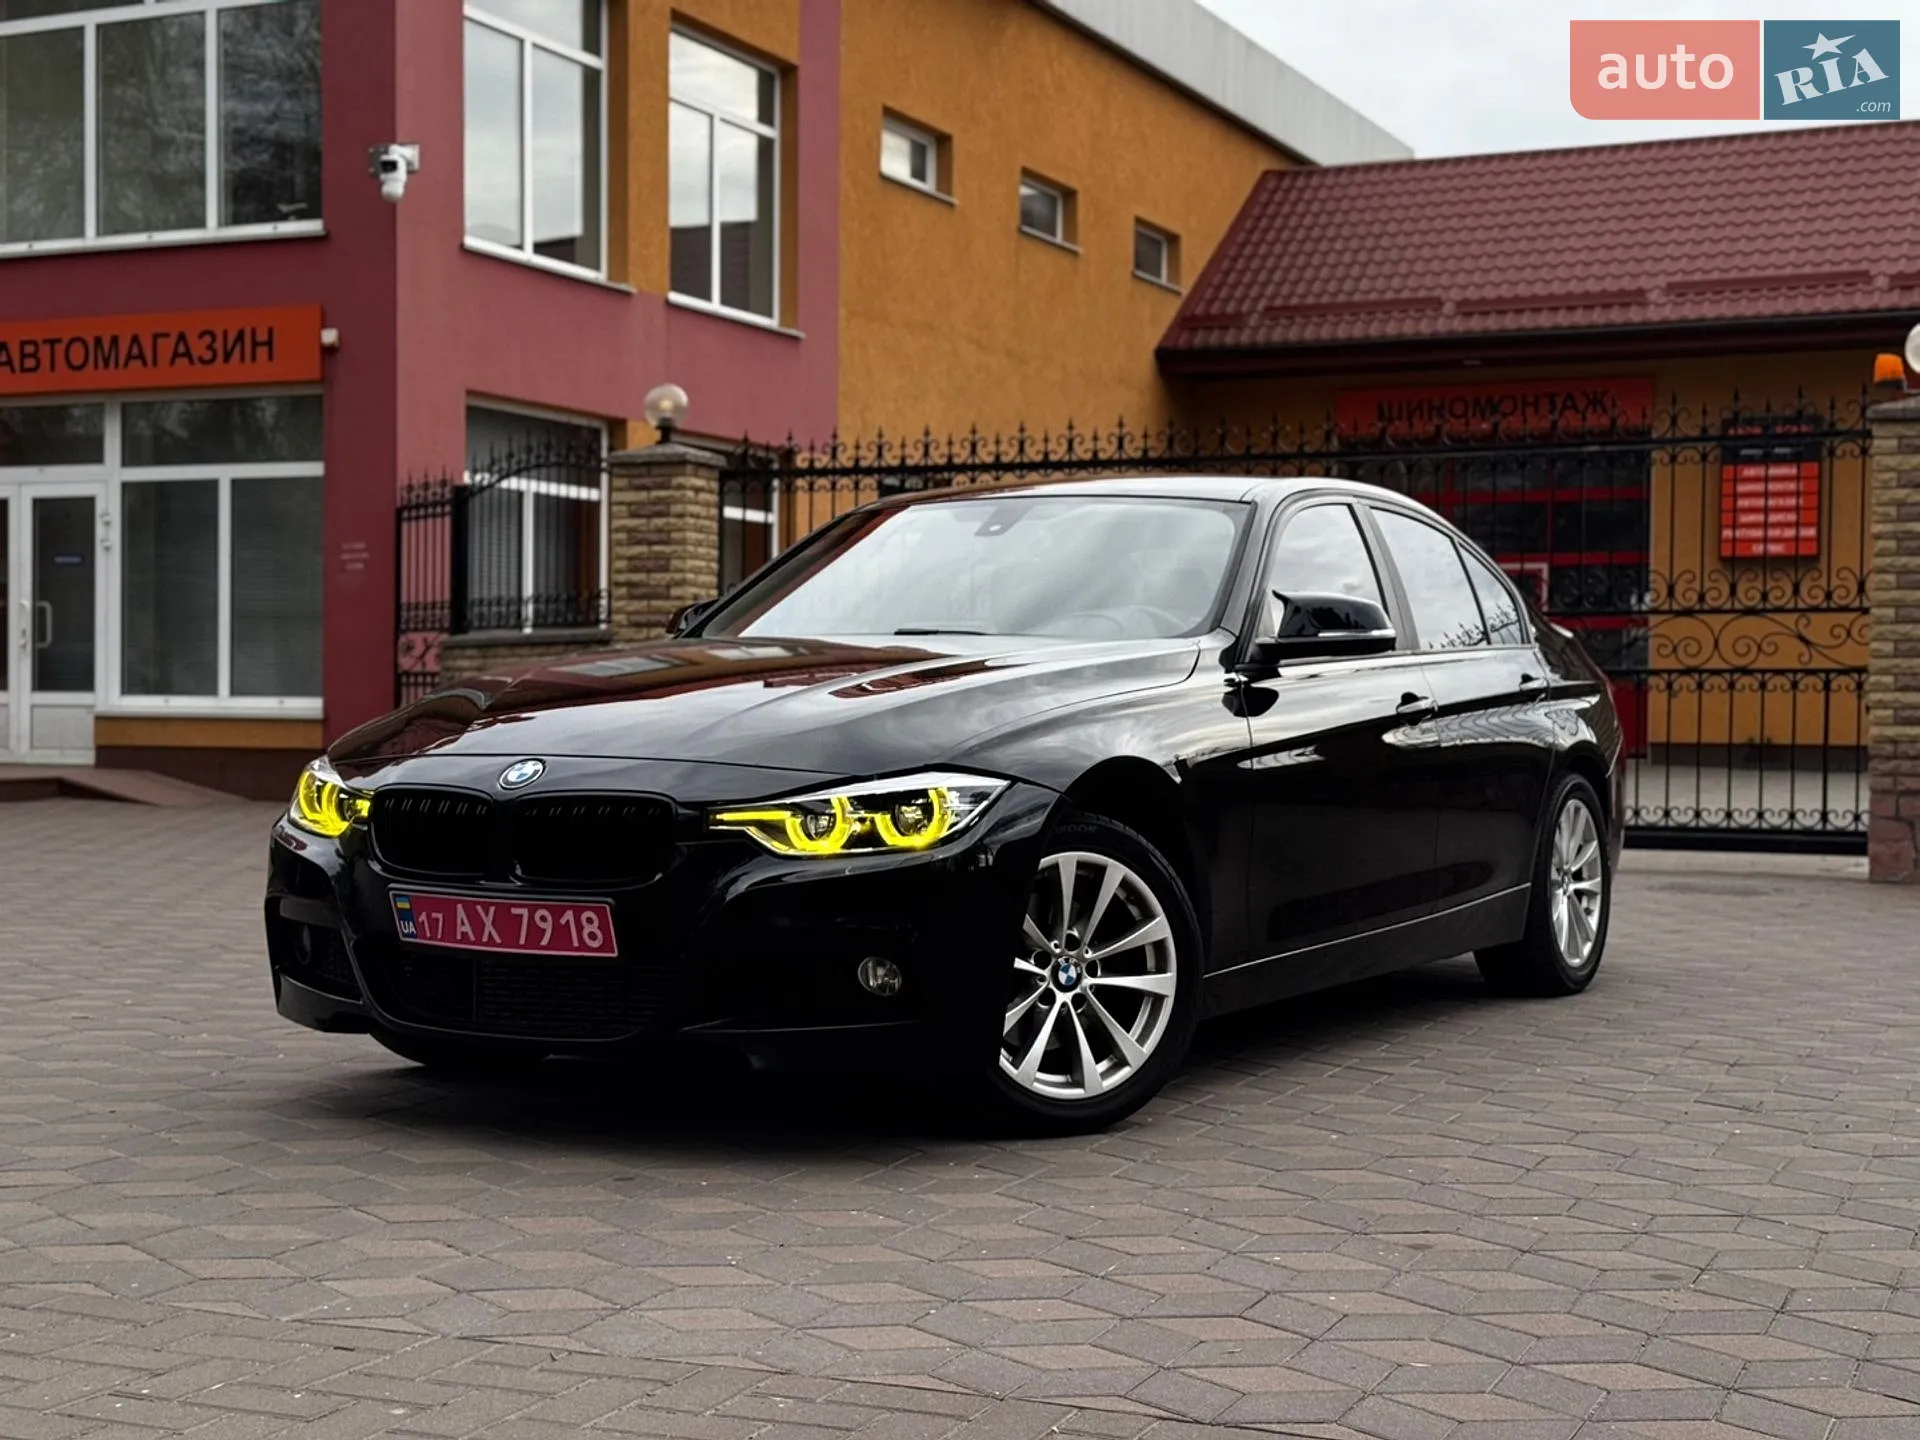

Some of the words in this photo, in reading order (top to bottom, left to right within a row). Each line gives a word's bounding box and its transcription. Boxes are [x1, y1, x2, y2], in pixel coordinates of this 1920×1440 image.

[0, 327, 276, 374] АВТОМАГАЗИН
[400, 919, 417, 935] UA
[419, 911, 443, 939] 17
[456, 904, 502, 944] AX
[511, 907, 604, 949] 7918
